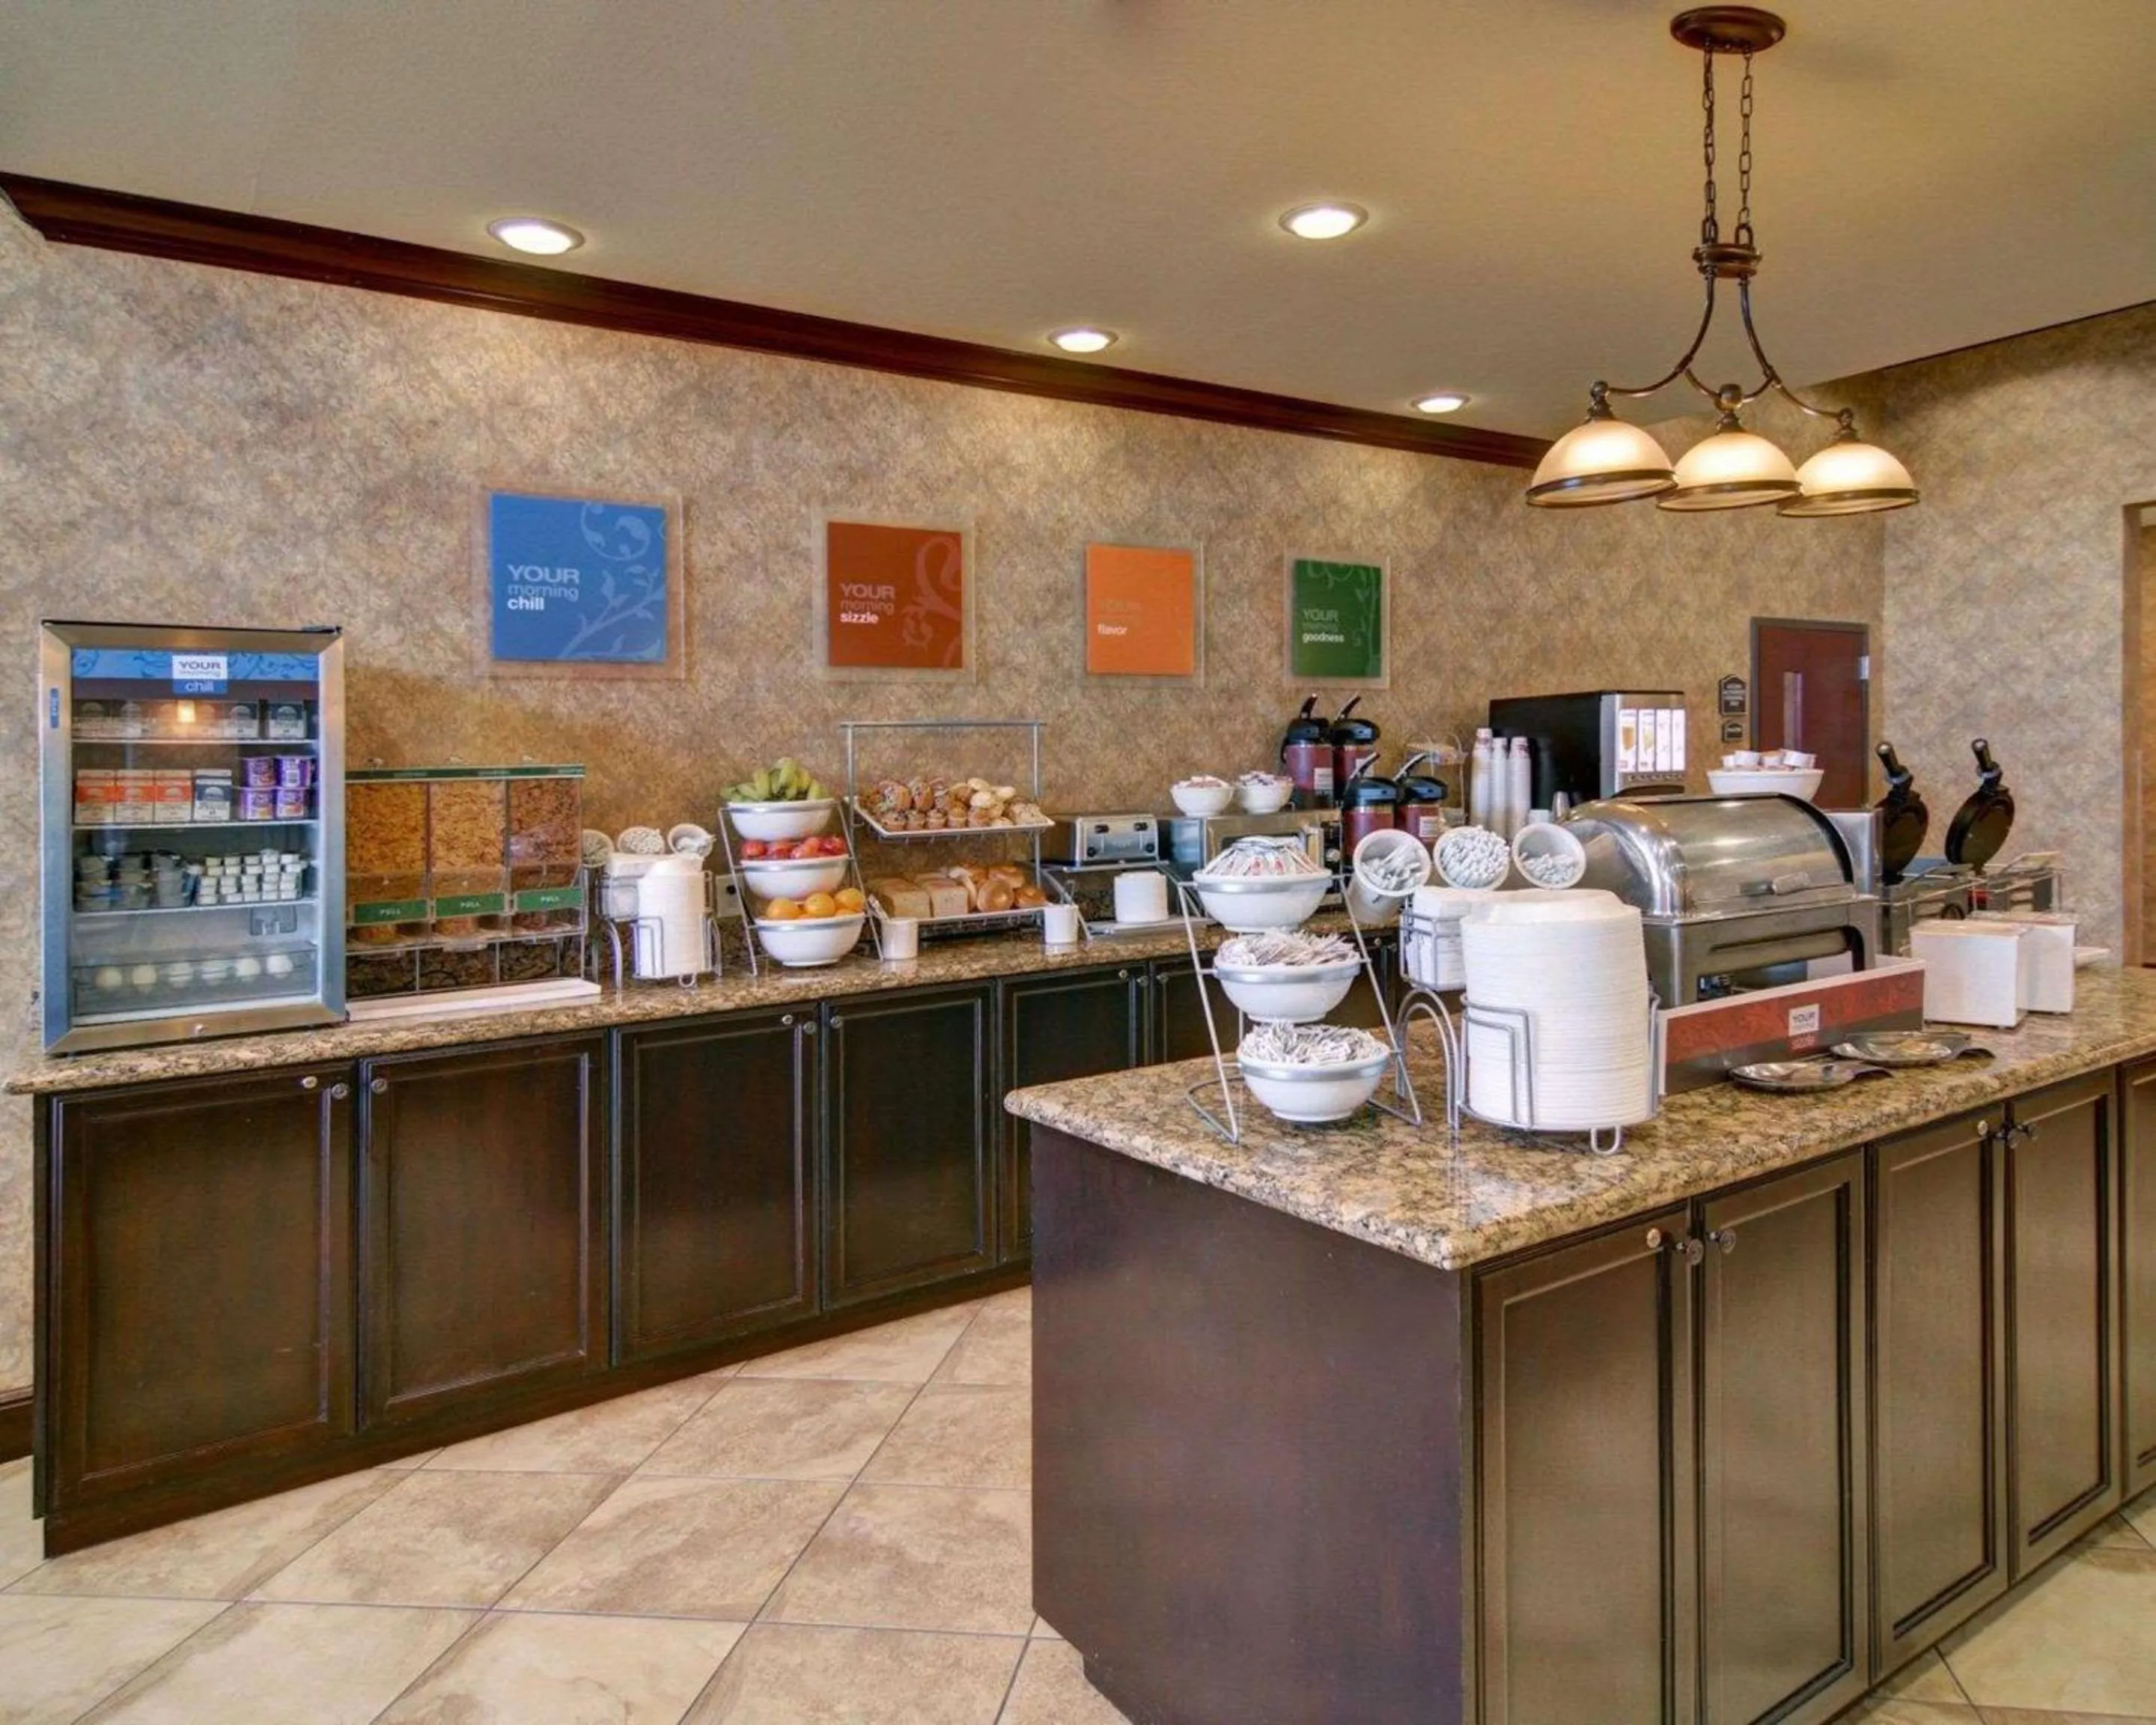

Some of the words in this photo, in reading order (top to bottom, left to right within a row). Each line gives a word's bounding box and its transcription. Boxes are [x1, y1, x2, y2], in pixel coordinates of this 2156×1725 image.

[508, 565, 579, 584] YOUR
[508, 585, 579, 602] morning
[840, 583, 895, 600] YOUR
[508, 596, 544, 610] chill
[841, 599, 894, 615] morning
[840, 612, 879, 624] sizzle
[1303, 609, 1339, 622] YOUR
[1097, 623, 1127, 636] flavor
[1303, 633, 1345, 644] goodness
[179, 661, 222, 669] YOUR
[186, 680, 213, 692] chill
[1792, 1011, 1815, 1023] YOUR
